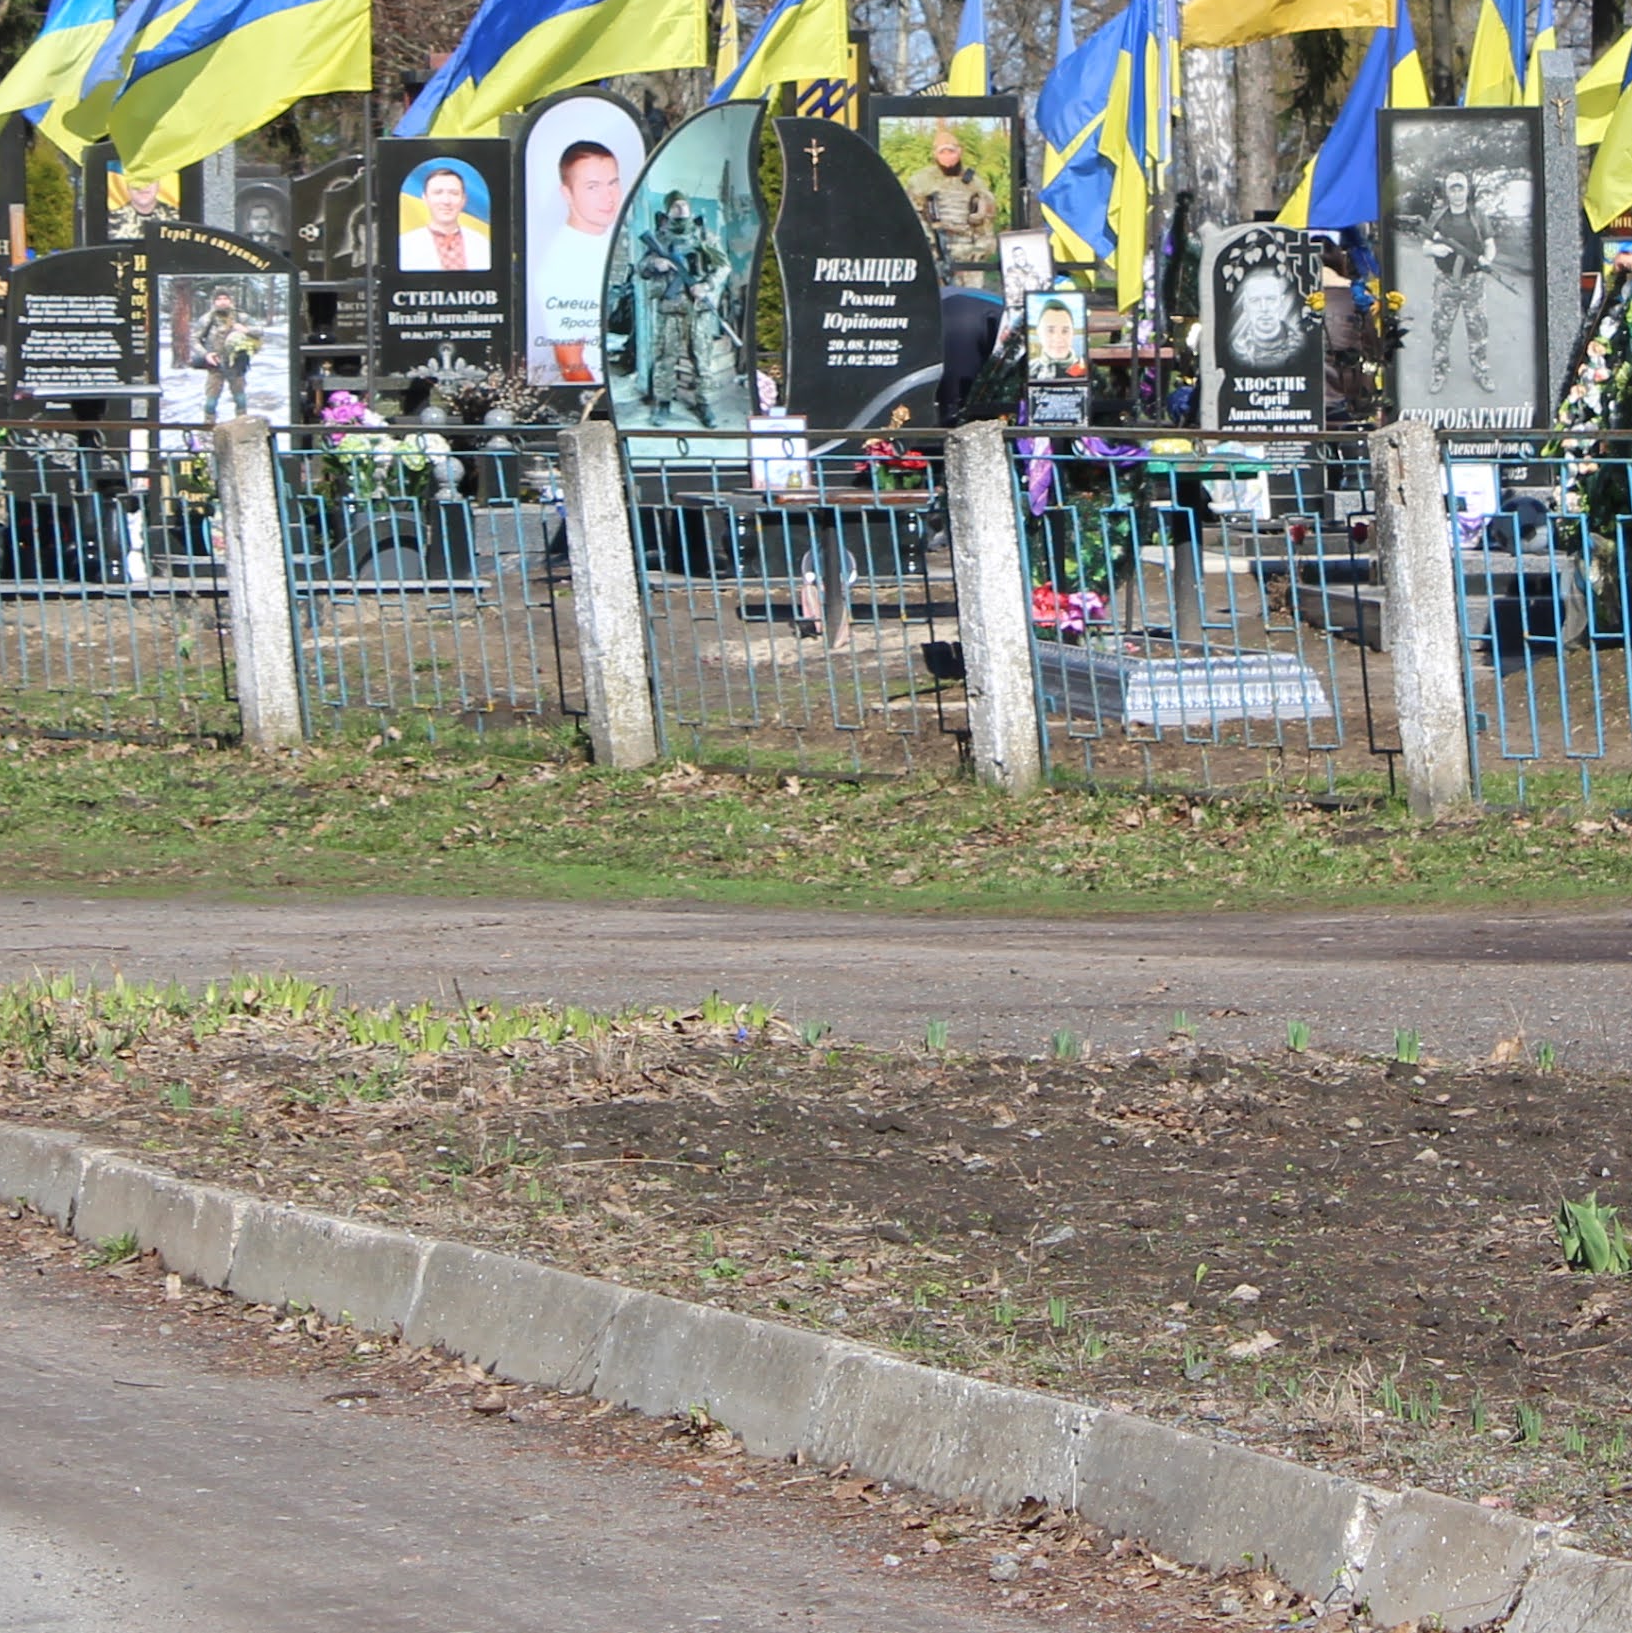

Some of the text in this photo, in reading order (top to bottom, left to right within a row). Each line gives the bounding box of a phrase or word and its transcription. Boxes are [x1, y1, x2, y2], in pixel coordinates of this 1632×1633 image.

[813, 257, 918, 288] РЯЗАНЦЕВ
[392, 290, 499, 306] СТЕПАНОВ
[839, 289, 898, 307] Роман
[822, 312, 909, 333] Юрійович
[1233, 377, 1307, 392] ХВОСТИК
[1248, 391, 1290, 409] Сергій
